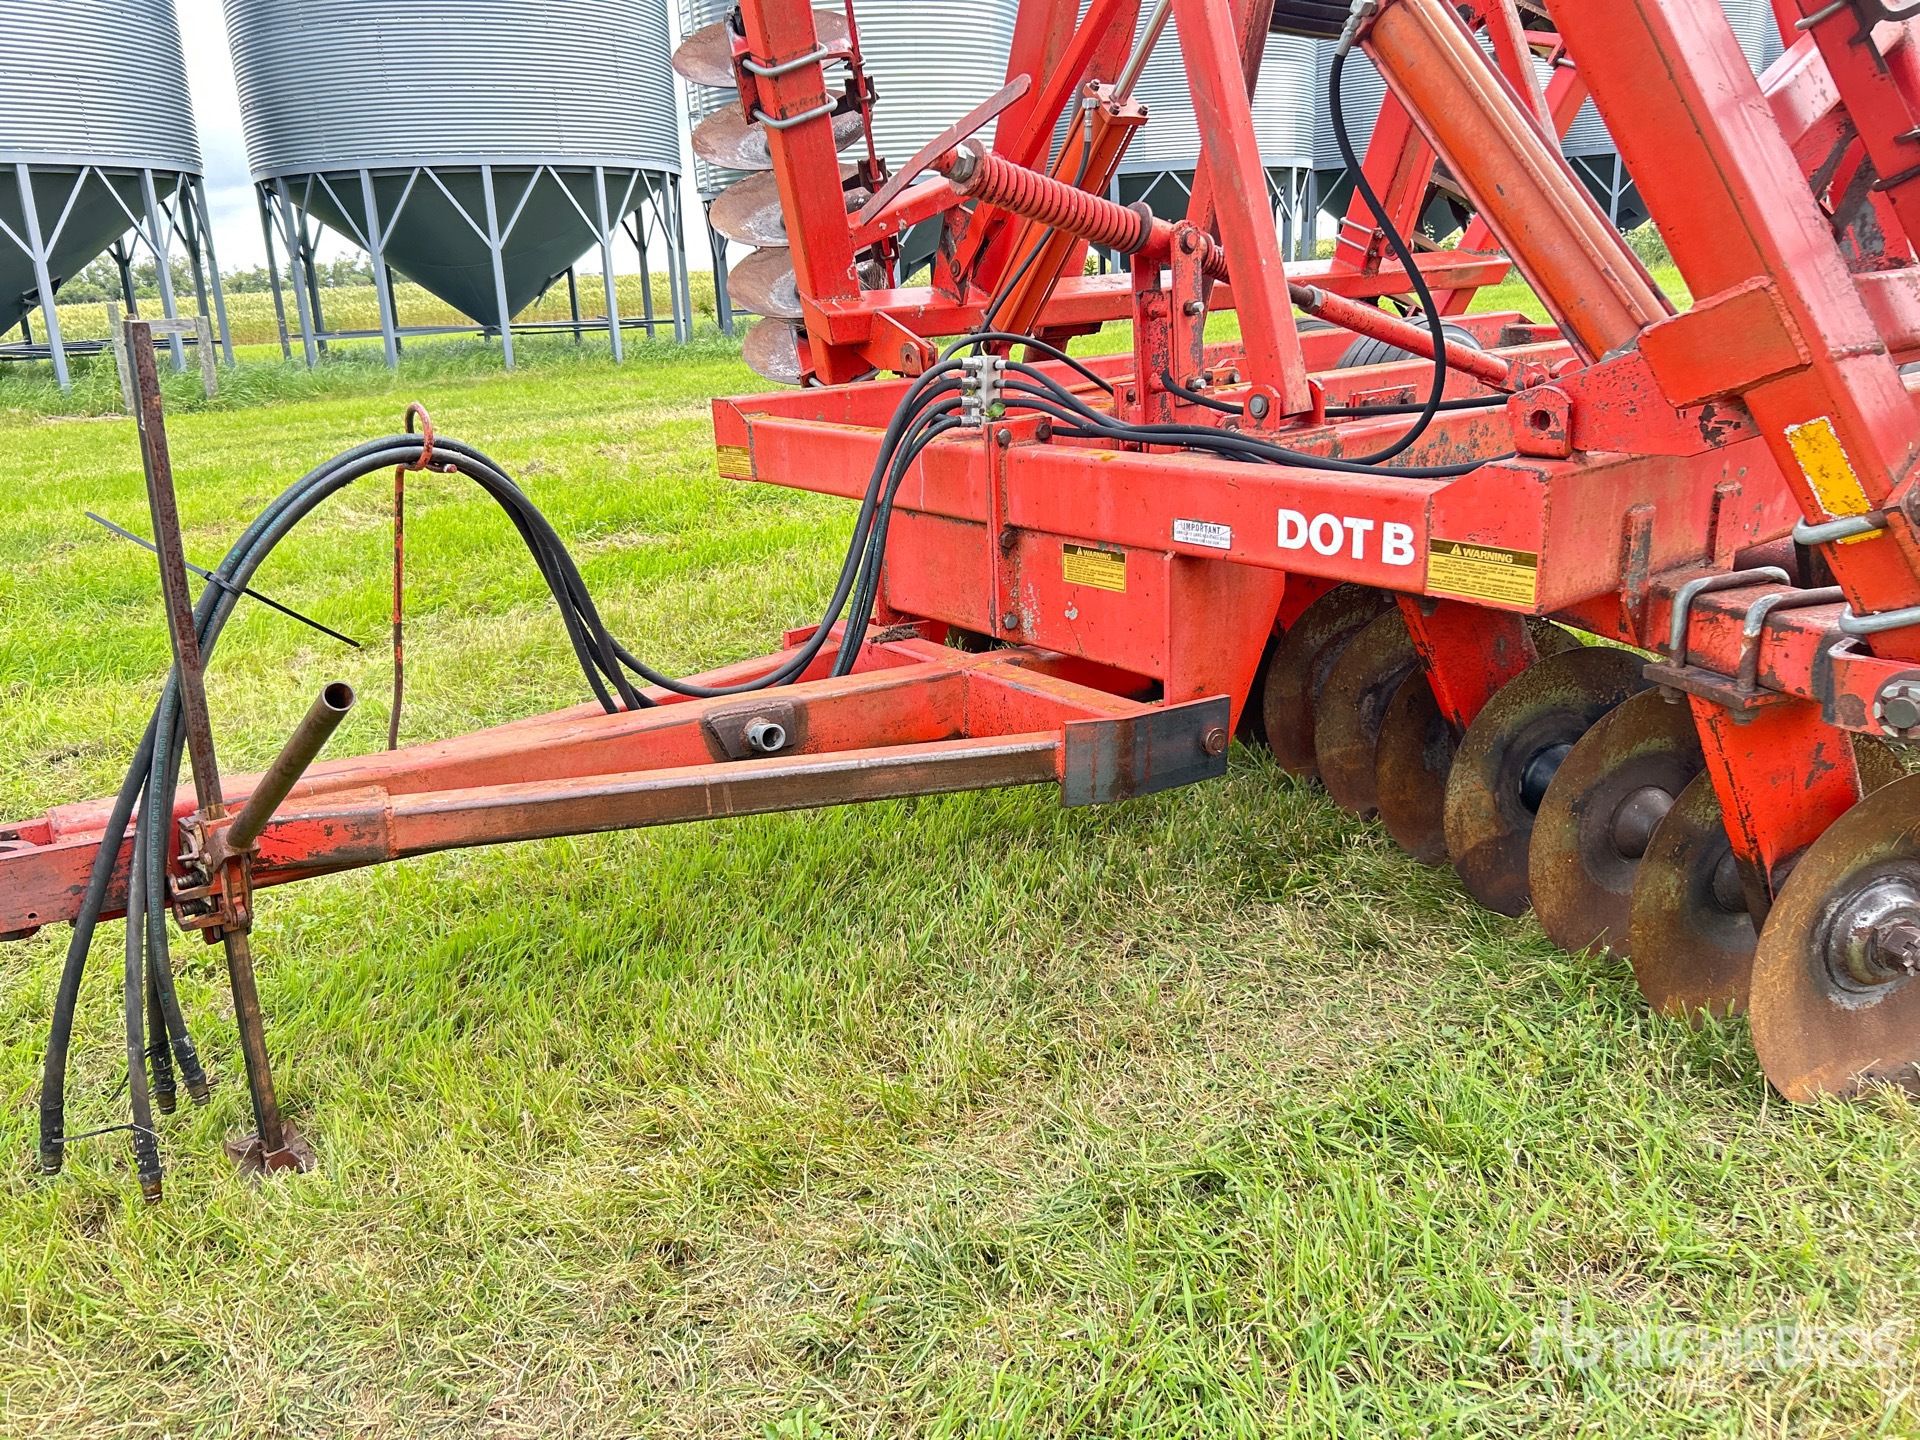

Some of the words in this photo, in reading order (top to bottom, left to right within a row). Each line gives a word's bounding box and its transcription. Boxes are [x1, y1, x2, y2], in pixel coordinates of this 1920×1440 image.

[1183, 522, 1221, 535] IMPORTANT
[1278, 509, 1374, 559] DOT
[1382, 522, 1415, 565] B
[1083, 550, 1112, 560] WARNING
[1463, 548, 1513, 563] WARNING
[155, 763, 163, 776] bar
[154, 778, 162, 794] 275
